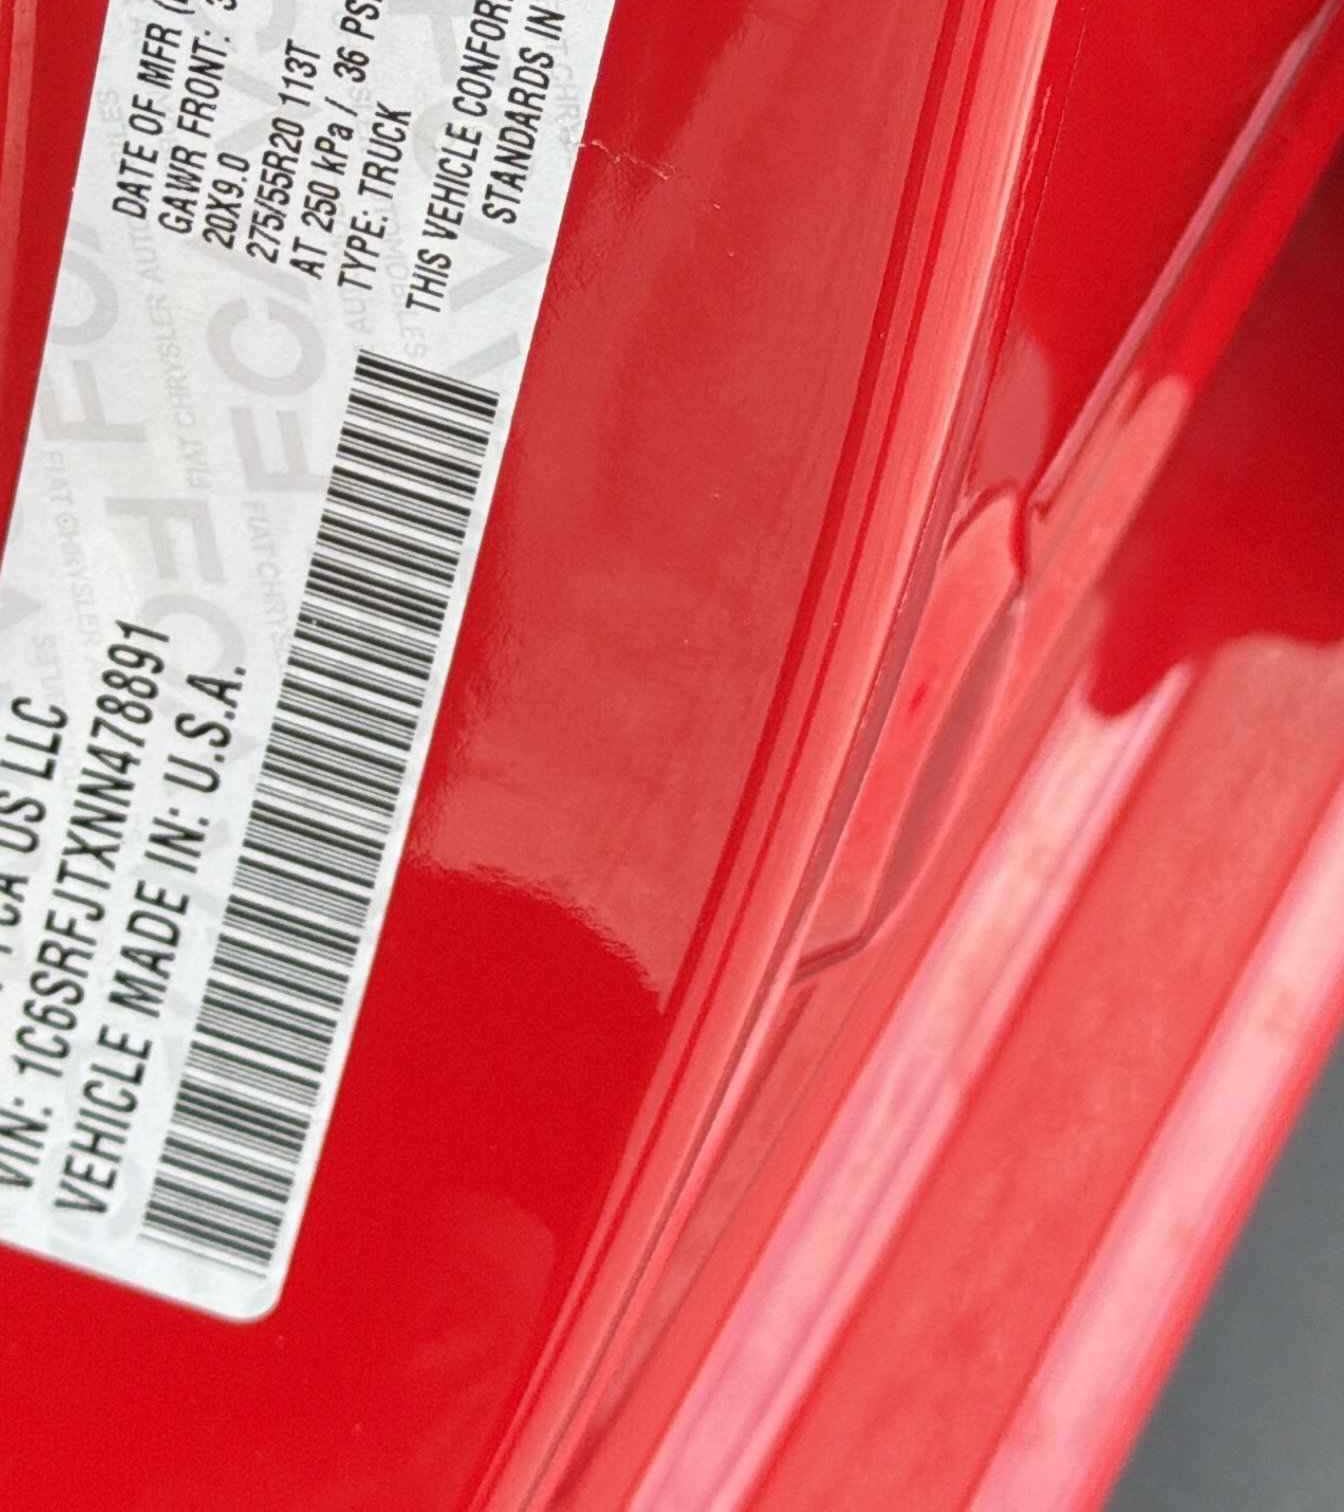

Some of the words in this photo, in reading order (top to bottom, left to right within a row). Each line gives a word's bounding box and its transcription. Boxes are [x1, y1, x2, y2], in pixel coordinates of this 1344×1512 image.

[136, 22, 181, 89] MFR
[176, 30, 229, 137] FRONT:
[333, 46, 369, 82] 36
[128, 94, 165, 135] OF
[324, 96, 357, 116] /
[481, 47, 553, 224] STANDARDS
[524, 5, 565, 40] IN
[112, 140, 158, 219] DATE
[158, 145, 206, 233] GAWR
[245, 117, 304, 263] 275/55R20
[278, 38, 320, 106] 113T
[310, 122, 353, 175] kPa
[357, 101, 411, 198] TRUCK
[422, 122, 481, 239] VEHICLE
[201, 152, 249, 249] 20X9.0
[300, 180, 340, 232] 250
[289, 236, 327, 279] AT
[337, 210, 387, 289] TYPE:
[405, 249, 451, 312] THIS
[0, 697, 67, 780] LLC
[163, 667, 245, 792] U.S.A.
[14, 620, 168, 1076] 1C6SRFJTXNN478891
[145, 808, 208, 873] IN:
[108, 880, 188, 1017] MADE
[55, 1026, 150, 1213] VEHICLE
